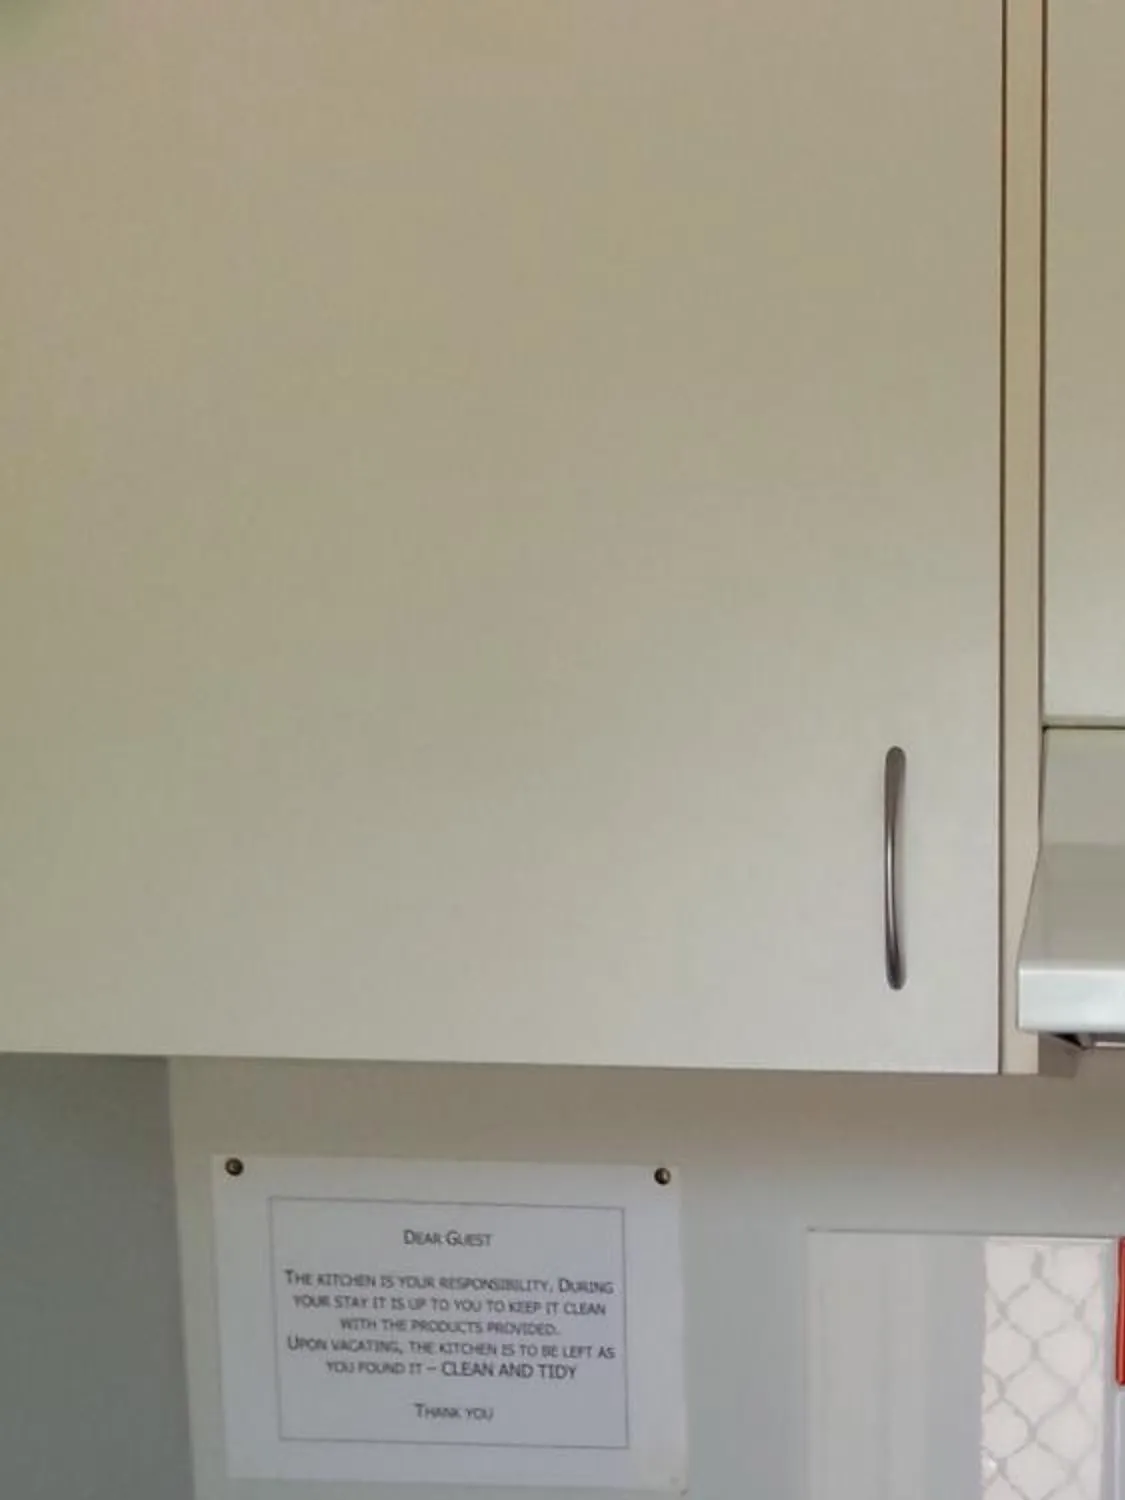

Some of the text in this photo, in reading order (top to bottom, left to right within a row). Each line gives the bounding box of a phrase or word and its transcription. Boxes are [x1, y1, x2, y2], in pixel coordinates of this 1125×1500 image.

[403, 1229, 492, 1246] DEAR GUEST
[285, 1269, 312, 1286] THE
[317, 1273, 376, 1287] KITCHEN
[380, 1275, 394, 1288] IS
[400, 1276, 435, 1289] YOUR
[559, 1278, 614, 1294] DURING
[293, 1295, 606, 1315] YOUR STAY IT IS UP TO YOU TO KEEP IT CLEAN
[340, 1318, 377, 1330] WITH
[381, 1319, 407, 1331] THE
[411, 1320, 483, 1333] PRODUCTS
[287, 1335, 327, 1351] UPON
[409, 1341, 434, 1354] THE
[439, 1342, 497, 1355] KITCHEN
[502, 1343, 516, 1356] IS
[520, 1344, 538, 1357] TO
[542, 1345, 559, 1358] BE
[563, 1346, 593, 1358] LEFT
[598, 1346, 616, 1359] AS
[326, 1361, 355, 1373] YOU
[358, 1361, 405, 1374] FOUND
[409, 1362, 422, 1375] IT
[441, 1360, 494, 1377] CLEAN
[499, 1362, 534, 1379] AND
[537, 1363, 577, 1379] TIDY
[414, 1402, 494, 1421] THANK YOU
